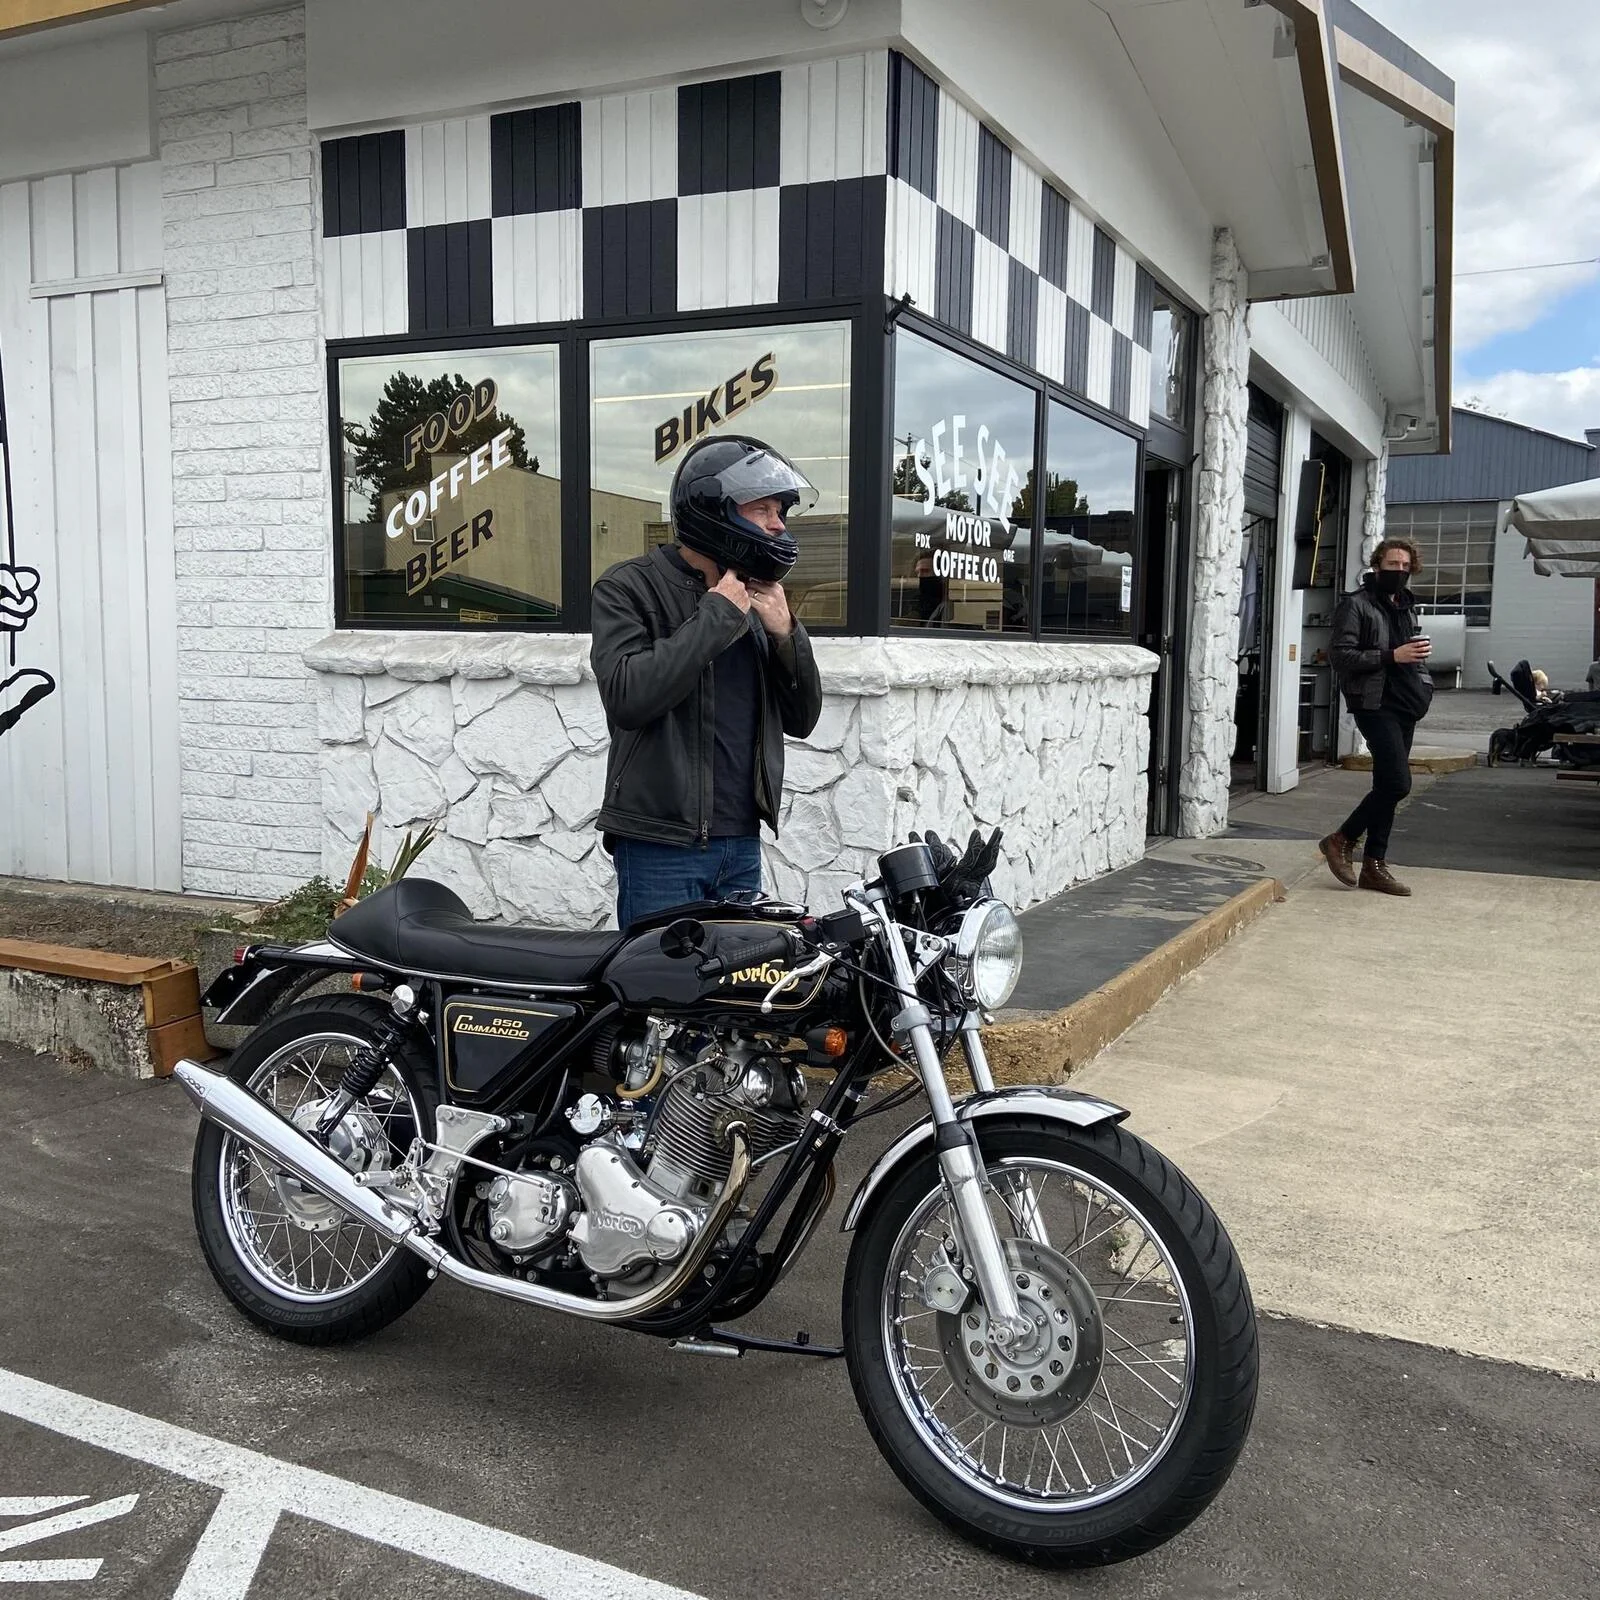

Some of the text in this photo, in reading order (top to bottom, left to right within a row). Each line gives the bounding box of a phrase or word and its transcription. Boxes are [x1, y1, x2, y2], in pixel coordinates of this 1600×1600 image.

[404, 377, 498, 471] FOOD
[654, 350, 778, 465] BIKES
[386, 427, 514, 539] COFFEE
[914, 415, 1019, 534] SEE SEE
[915, 532, 931, 549] PDX
[946, 513, 992, 547] MOTOR
[406, 508, 495, 596] BEER
[933, 549, 1000, 583] COFFEE CO.
[1003, 549, 1015, 563] ORE
[453, 1015, 530, 1040] COMMANDO
[492, 1018, 523, 1028] 850
